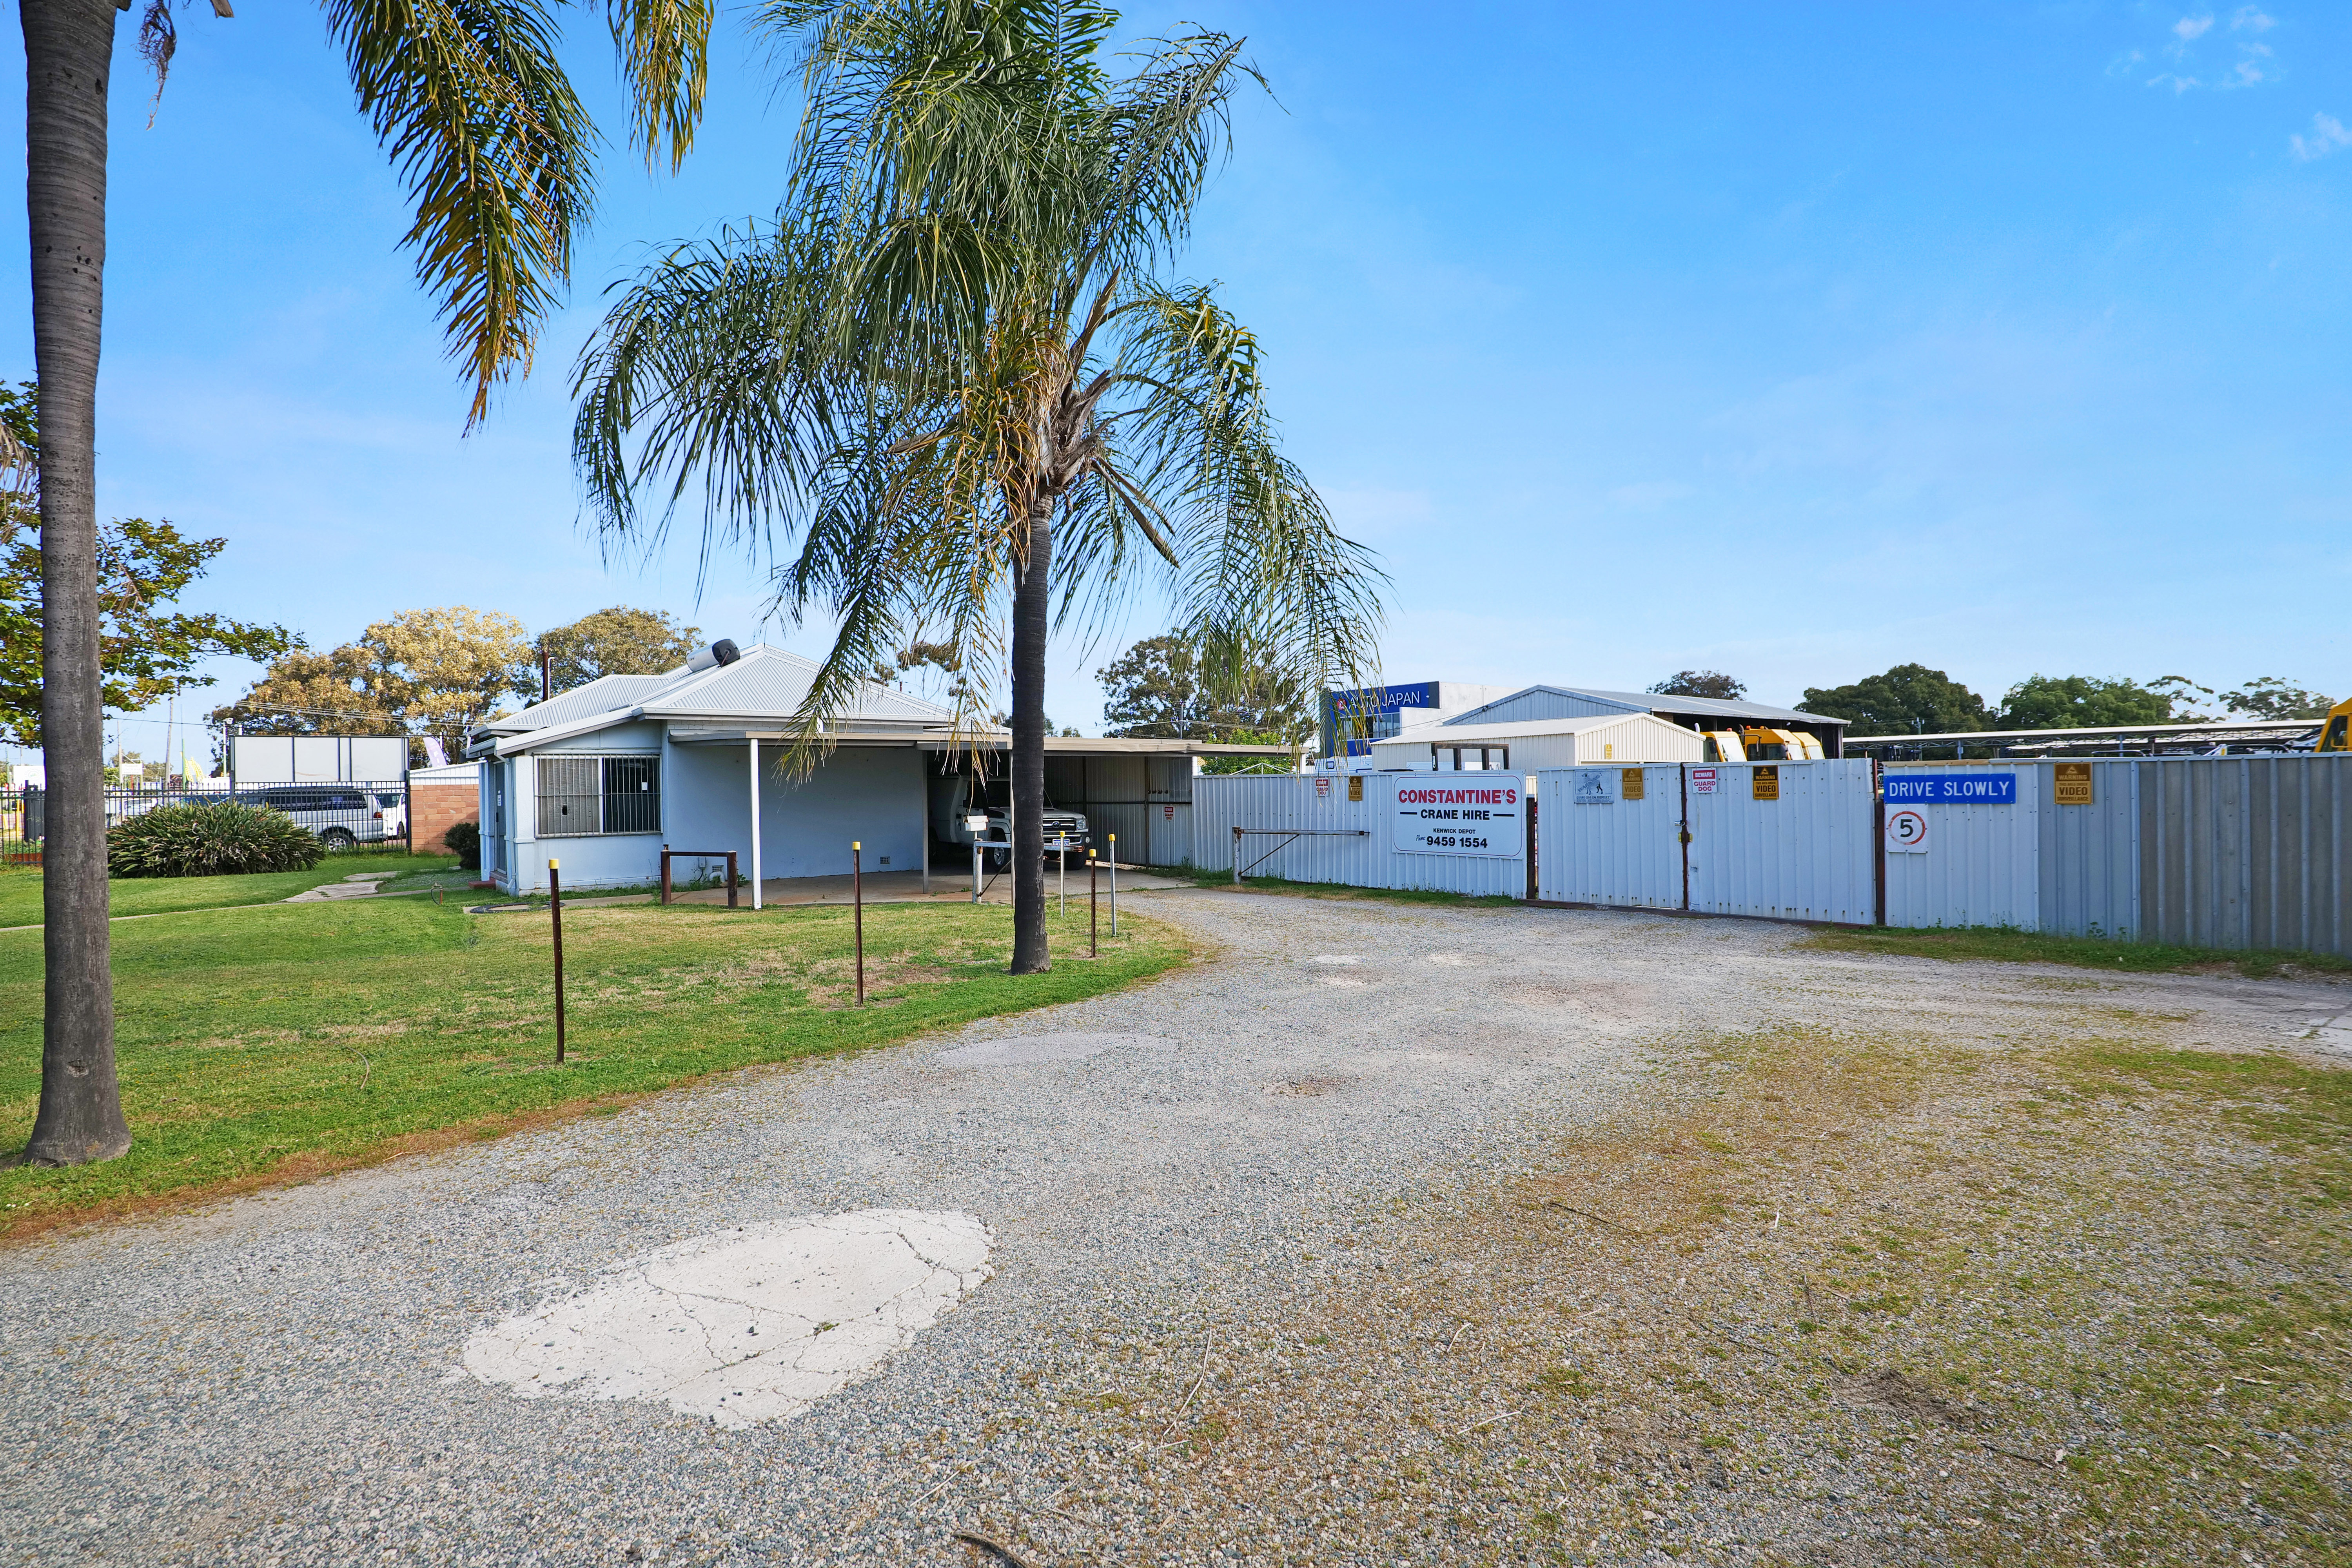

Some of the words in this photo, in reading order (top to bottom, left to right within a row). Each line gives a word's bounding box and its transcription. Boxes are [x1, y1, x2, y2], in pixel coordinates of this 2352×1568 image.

[1382, 691, 1420, 706] JAPAN
[1399, 789, 1516, 804] CONSTANTINE'S
[1889, 782, 1934, 797] DRIVE
[1943, 781, 2009, 796] SLOWLY
[2059, 787, 2088, 795] VIDEO
[1421, 809, 1458, 819] CRANE
[1463, 810, 1490, 820] HIRE
[1900, 818, 1913, 838] 5
[1426, 836, 1455, 847] 9459
[1459, 837, 1488, 848] 1554
